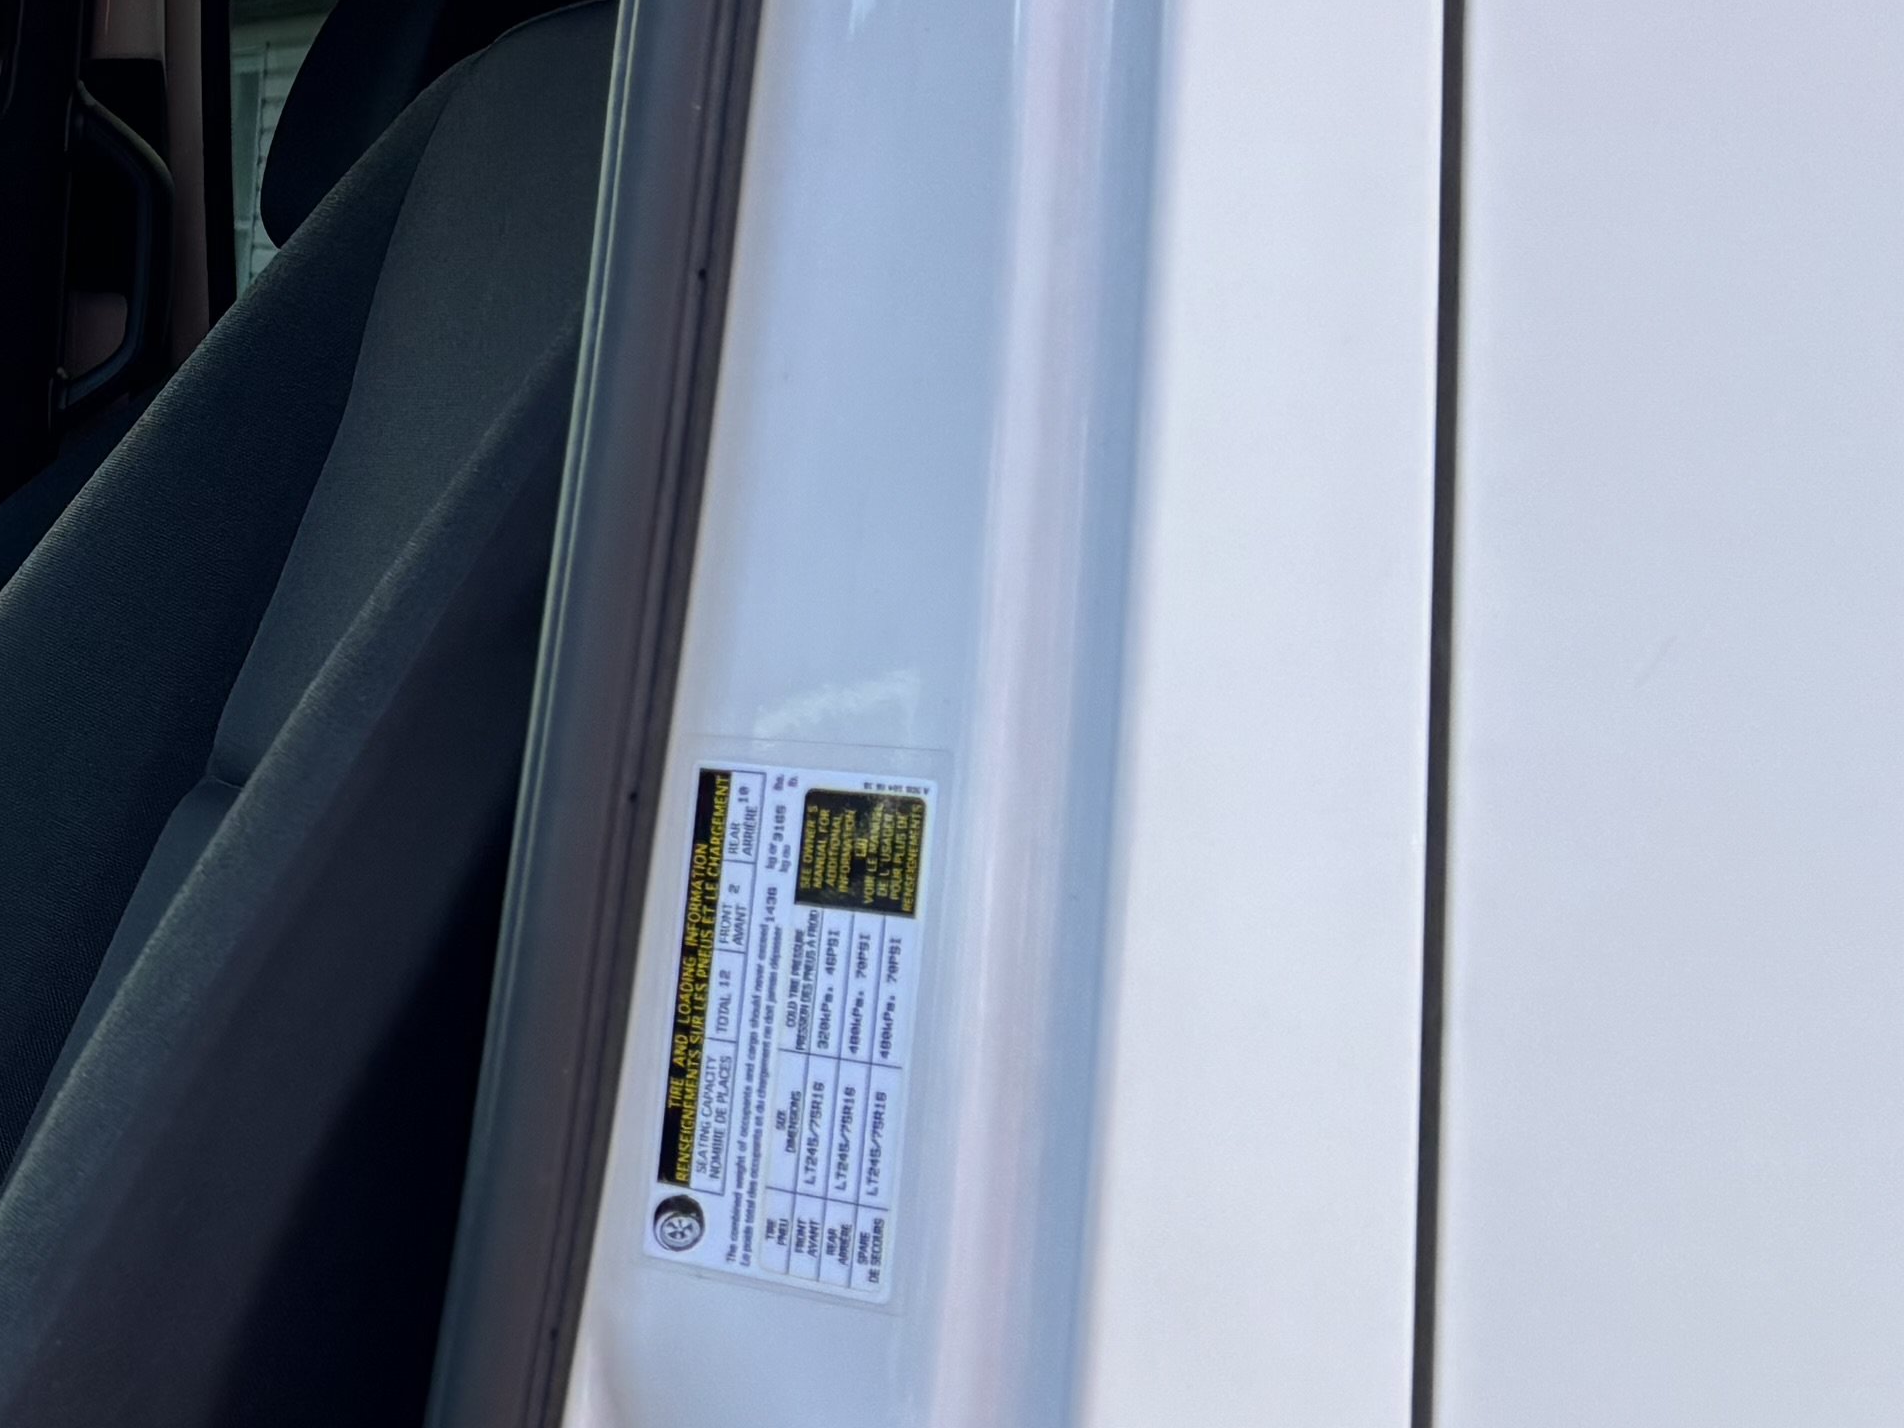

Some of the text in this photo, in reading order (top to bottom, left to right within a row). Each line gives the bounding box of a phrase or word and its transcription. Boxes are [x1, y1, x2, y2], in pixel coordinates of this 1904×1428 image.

[737, 785, 750, 802] 10
[727, 822, 741, 854] REAR
[812, 809, 830, 888] MANUAL FOR
[825, 813, 842, 886] ADDITIONAL
[837, 808, 856, 892] INFORMATION
[893, 832, 906, 863] PLUS
[866, 857, 877, 872] LE
[889, 868, 902, 900] POUR
[728, 883, 740, 894] 2
[764, 886, 777, 922] 1436
[863, 875, 876, 904] VOIR
[877, 882, 888, 896] DE
[718, 902, 733, 943] FRONT
[732, 904, 746, 945] AVANT
[855, 932, 870, 979] 70PSI
[885, 936, 901, 983] 70PSI
[667, 843, 708, 1109] TIRE AND LOADING INFORMATION
[674, 775, 729, 1181] RENSEIGNEMENTS SUR LES PNEUS ET LE CHARGEMENT
[715, 969, 731, 1033] TOTAL 12
[695, 1055, 717, 1173] SEATING CAPACITY
[708, 1054, 732, 1179] NOMBRE DE PLACES
[806, 1219, 820, 1257] AVANT
[825, 1227, 837, 1255] REAR
[868, 1267, 880, 1283] DE
